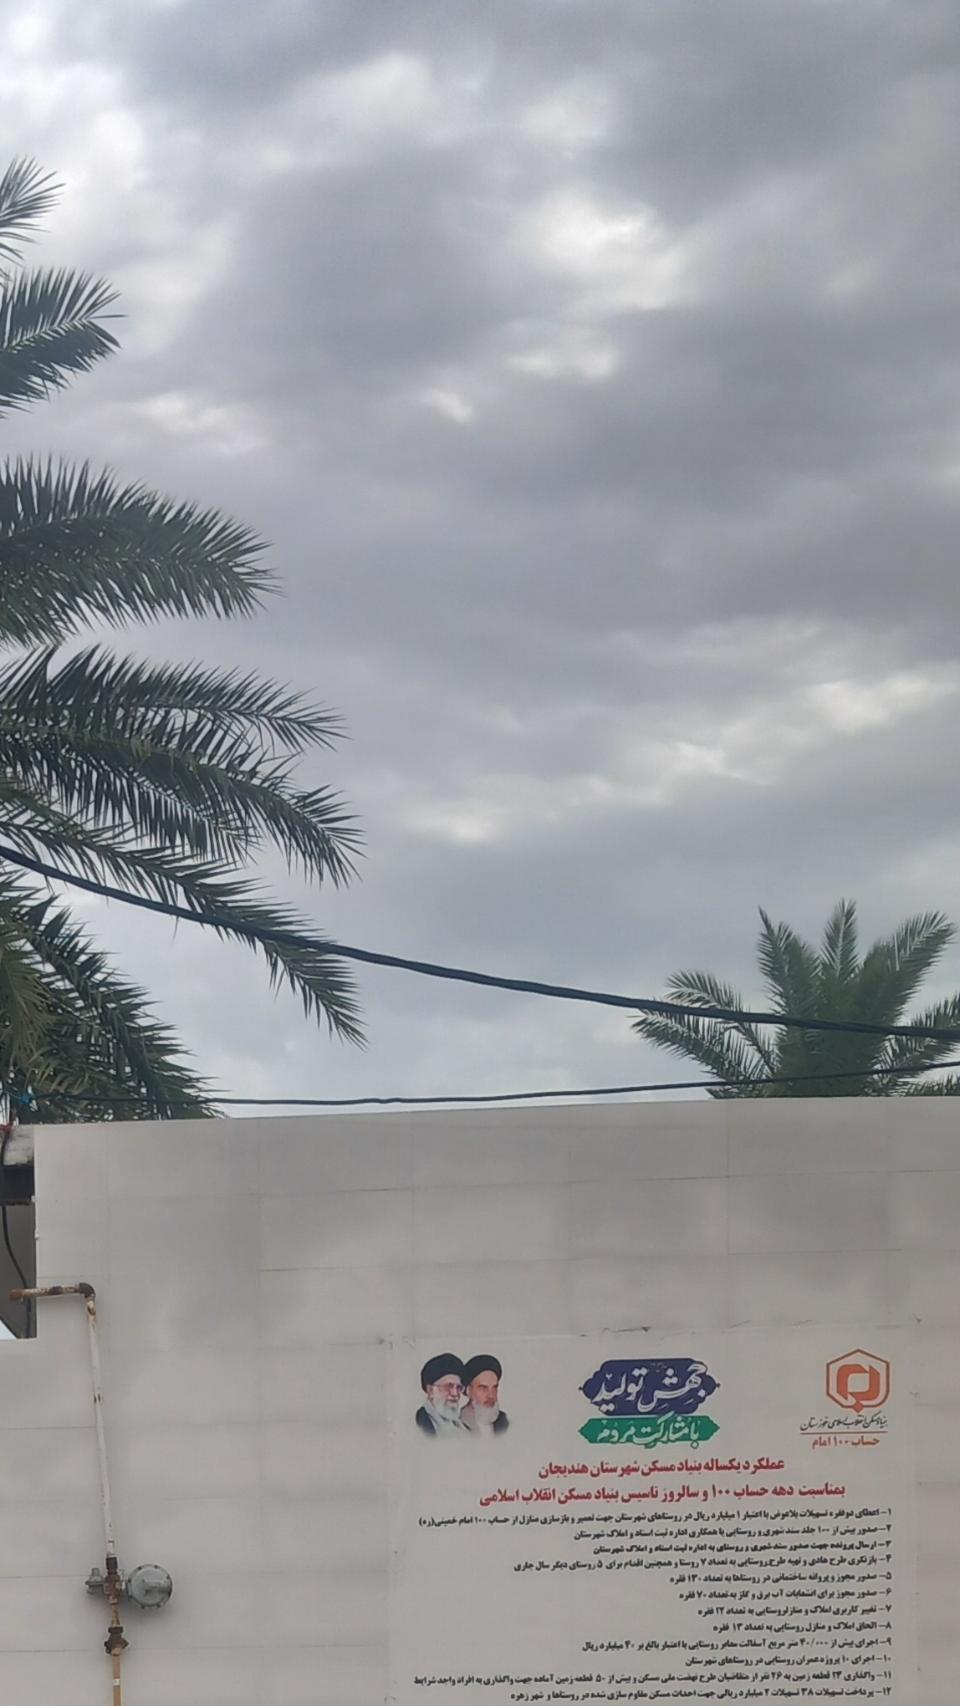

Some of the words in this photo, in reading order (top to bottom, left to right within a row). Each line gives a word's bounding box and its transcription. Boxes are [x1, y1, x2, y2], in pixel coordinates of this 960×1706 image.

[591, 1367, 648, 1412] تولید
[638, 1363, 707, 1412] جهش
[596, 1420, 636, 1443] مردم
[632, 1411, 689, 1449] مشارکت
[689, 1417, 701, 1449] با
[812, 1436, 832, 1450] امام
[851, 1436, 880, 1448] حساب
[538, 1462, 589, 1479] هندیجان
[590, 1461, 641, 1477] شهرستان
[641, 1460, 677, 1476] مسکن
[677, 1460, 702, 1474] بنیاد
[702, 1458, 742, 1473] یکساله
[743, 1457, 786, 1474] عملکرد
[520, 1488, 557, 1501] انقلاب
[558, 1488, 593, 1504] مسکن
[594, 1488, 620, 1502] بنیاد
[621, 1486, 659, 1503] تاسیس
[661, 1485, 700, 1502] سالروز
[712, 1485, 731, 1497] ۱۰۰
[733, 1485, 770, 1499] حساب
[771, 1486, 795, 1496] دهه
[798, 1483, 847, 1495] بمناسبت
[479, 1489, 520, 1506] اسلامی
[488, 1516, 511, 1525] حساب
[615, 1513, 647, 1523] شهرستان
[574, 1530, 607, 1540] شهرستان
